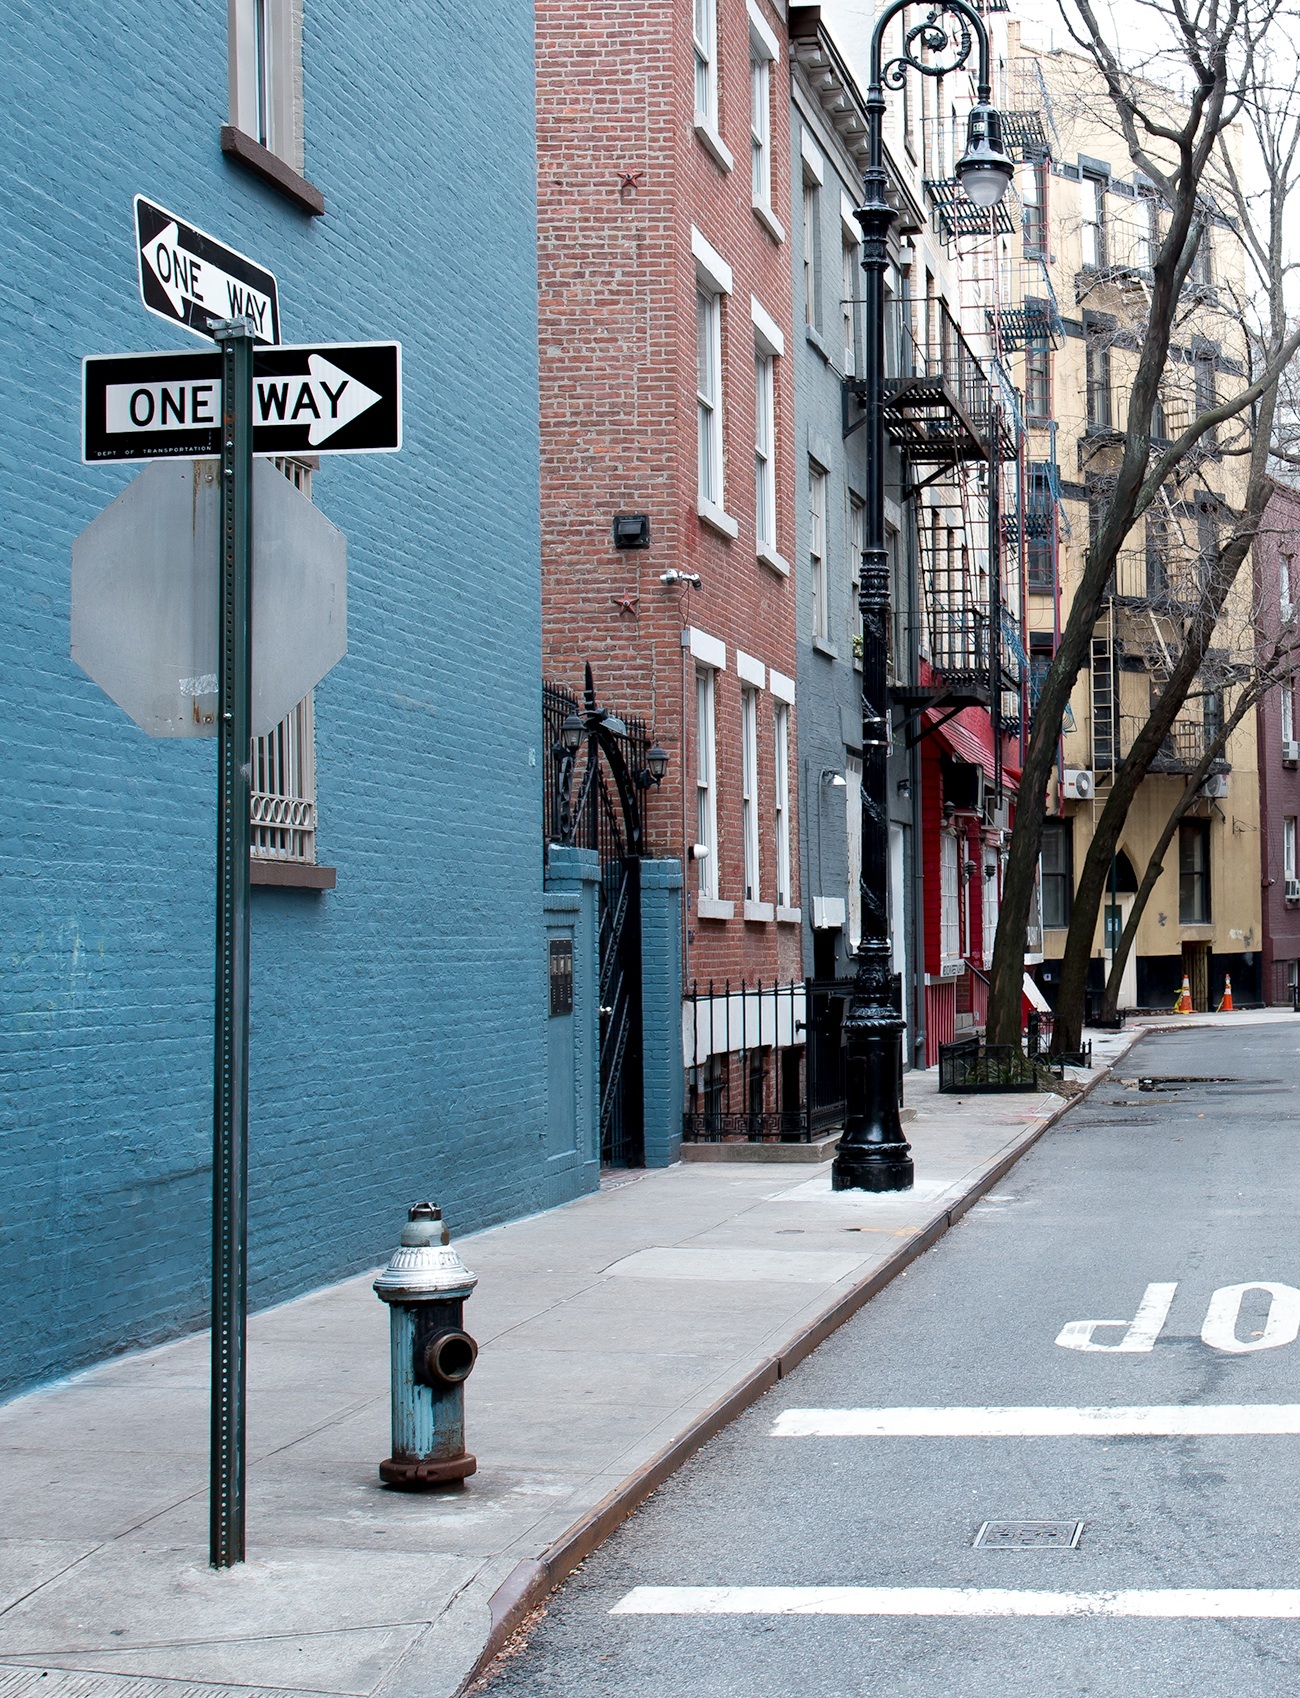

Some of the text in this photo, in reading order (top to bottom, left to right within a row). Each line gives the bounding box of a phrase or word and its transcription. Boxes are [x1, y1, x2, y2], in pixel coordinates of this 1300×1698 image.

[157, 242, 266, 334] ONE WAY
[129, 380, 350, 427] ONE WAY
[142, 445, 212, 454] TRANSPORTATION
